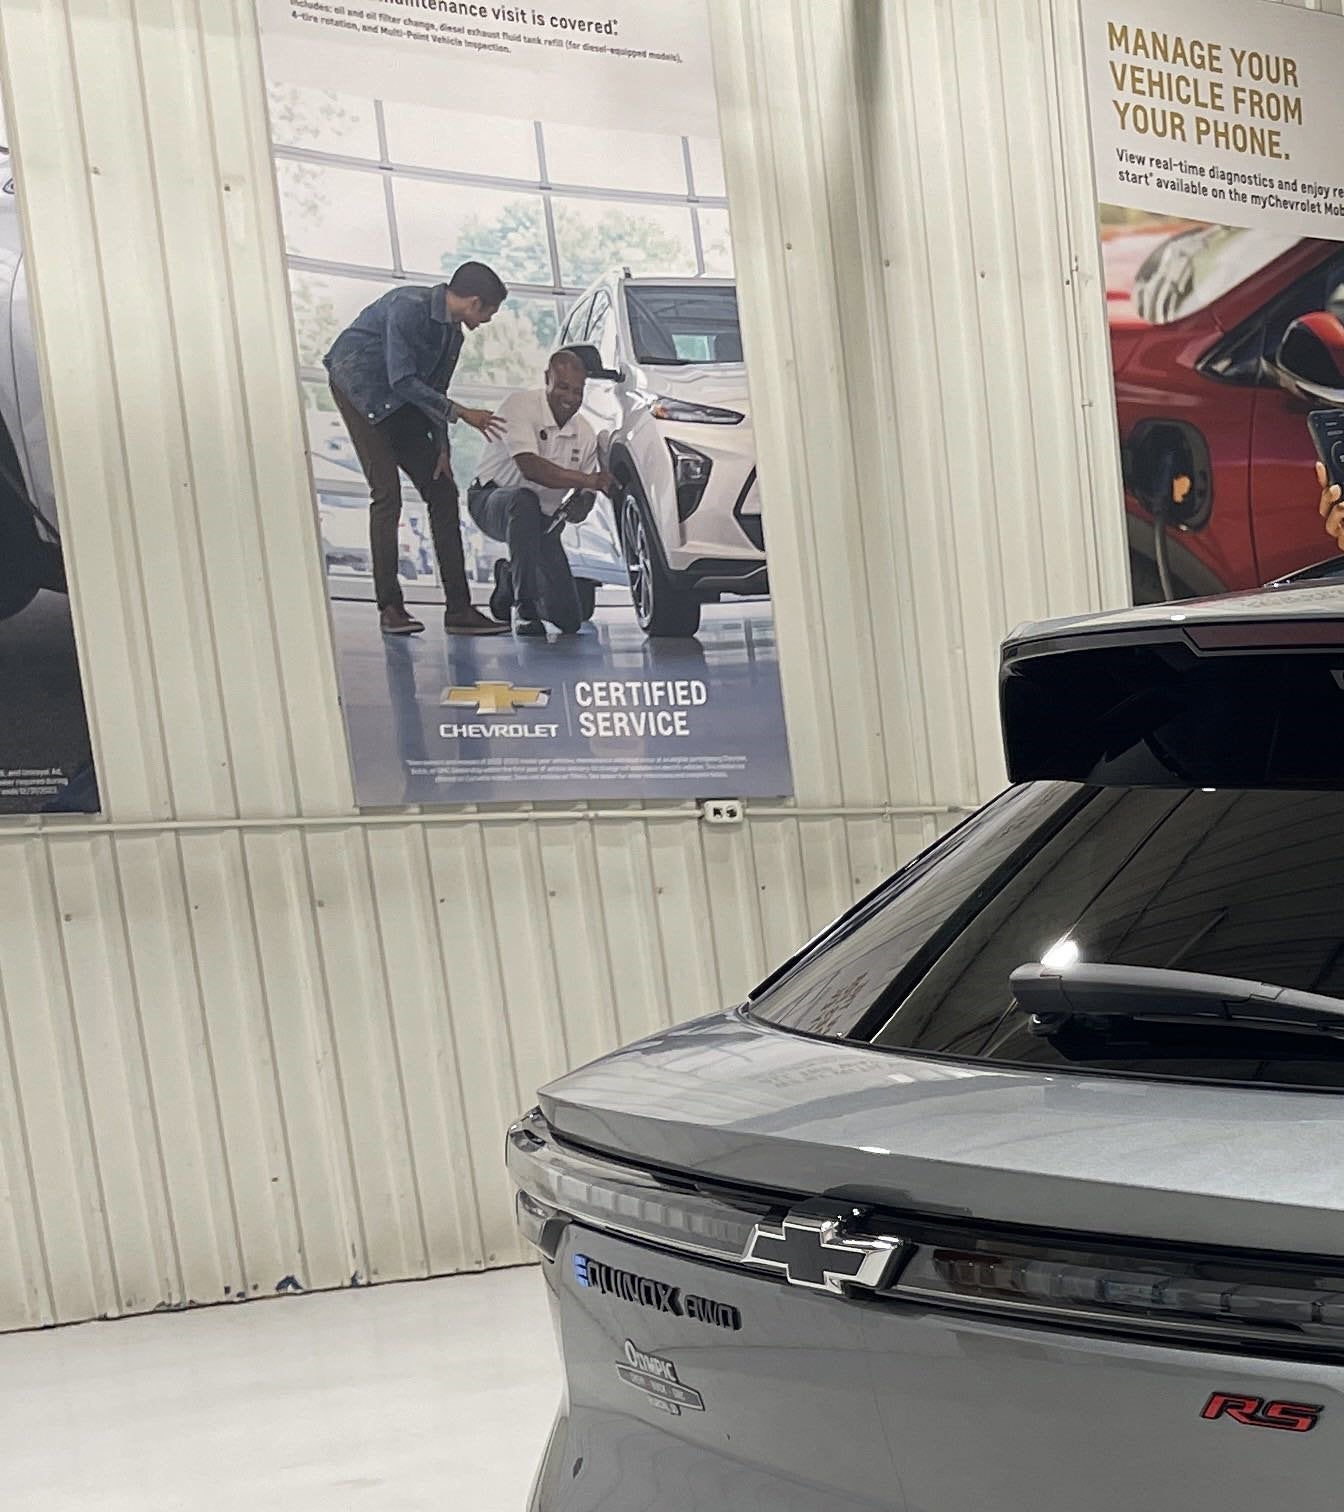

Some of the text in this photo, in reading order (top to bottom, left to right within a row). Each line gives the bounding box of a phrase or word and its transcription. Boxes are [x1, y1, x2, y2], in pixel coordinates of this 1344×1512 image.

[492, 5, 527, 24] visit
[532, 9, 545, 27] is
[1107, 21, 1299, 88] MANAGE YOUR
[1109, 61, 1303, 125] VEHICLE FROM
[1112, 100, 1291, 160] YOUR PHONE.
[1116, 148, 1146, 166] View
[1149, 156, 1206, 177] real-time
[1208, 166, 1275, 190] diagnostics
[1277, 177, 1298, 193] and
[1300, 180, 1330, 200] enjoy
[1156, 177, 1208, 197] available
[1211, 187, 1226, 199] on
[1228, 187, 1248, 203] the
[1250, 193, 1322, 215] myChevrolet
[575, 680, 707, 707] CERTIFIED
[439, 723, 559, 739] CHEVROLET
[579, 711, 691, 738] SERVICE
[1199, 1391, 1326, 1433] RS
